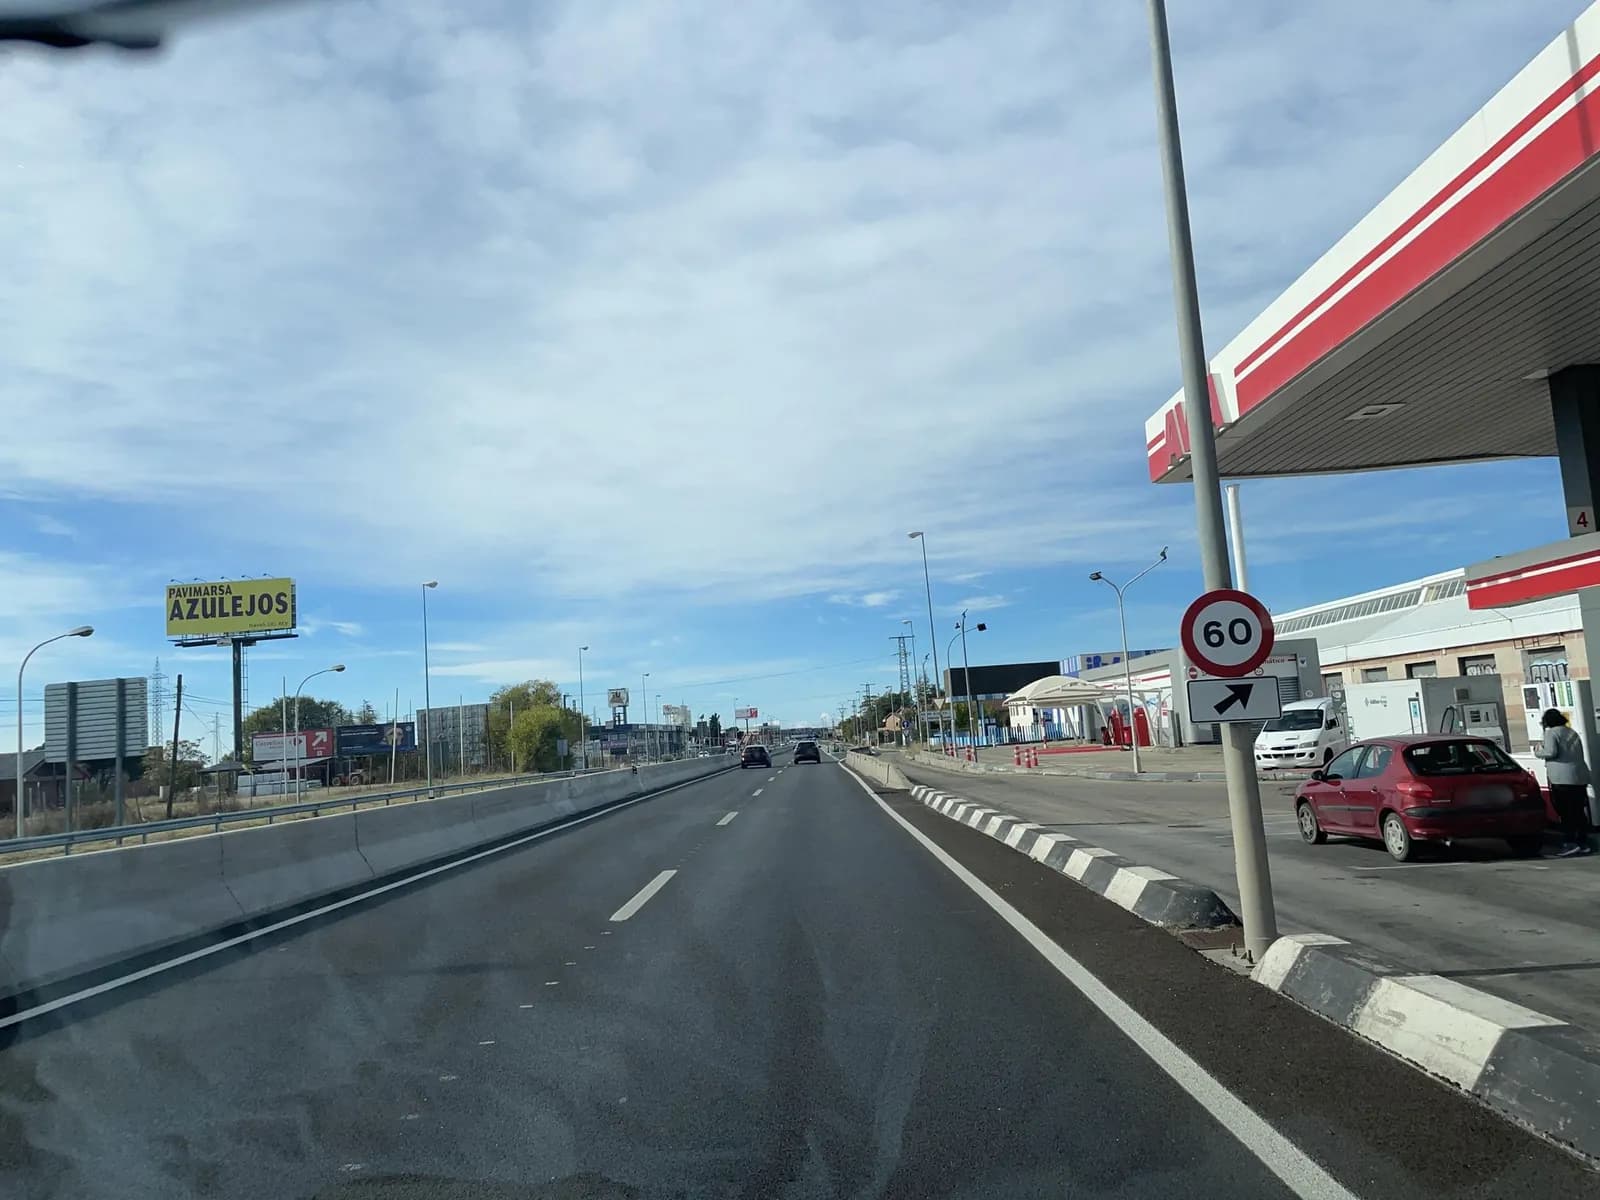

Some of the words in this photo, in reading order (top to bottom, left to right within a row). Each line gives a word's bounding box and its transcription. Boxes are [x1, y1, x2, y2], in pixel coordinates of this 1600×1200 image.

[1577, 511, 1589, 528] 4
[168, 584, 233, 599] PAVIMARSA
[169, 592, 289, 622] AZULEJOS
[1203, 617, 1252, 648] 60
